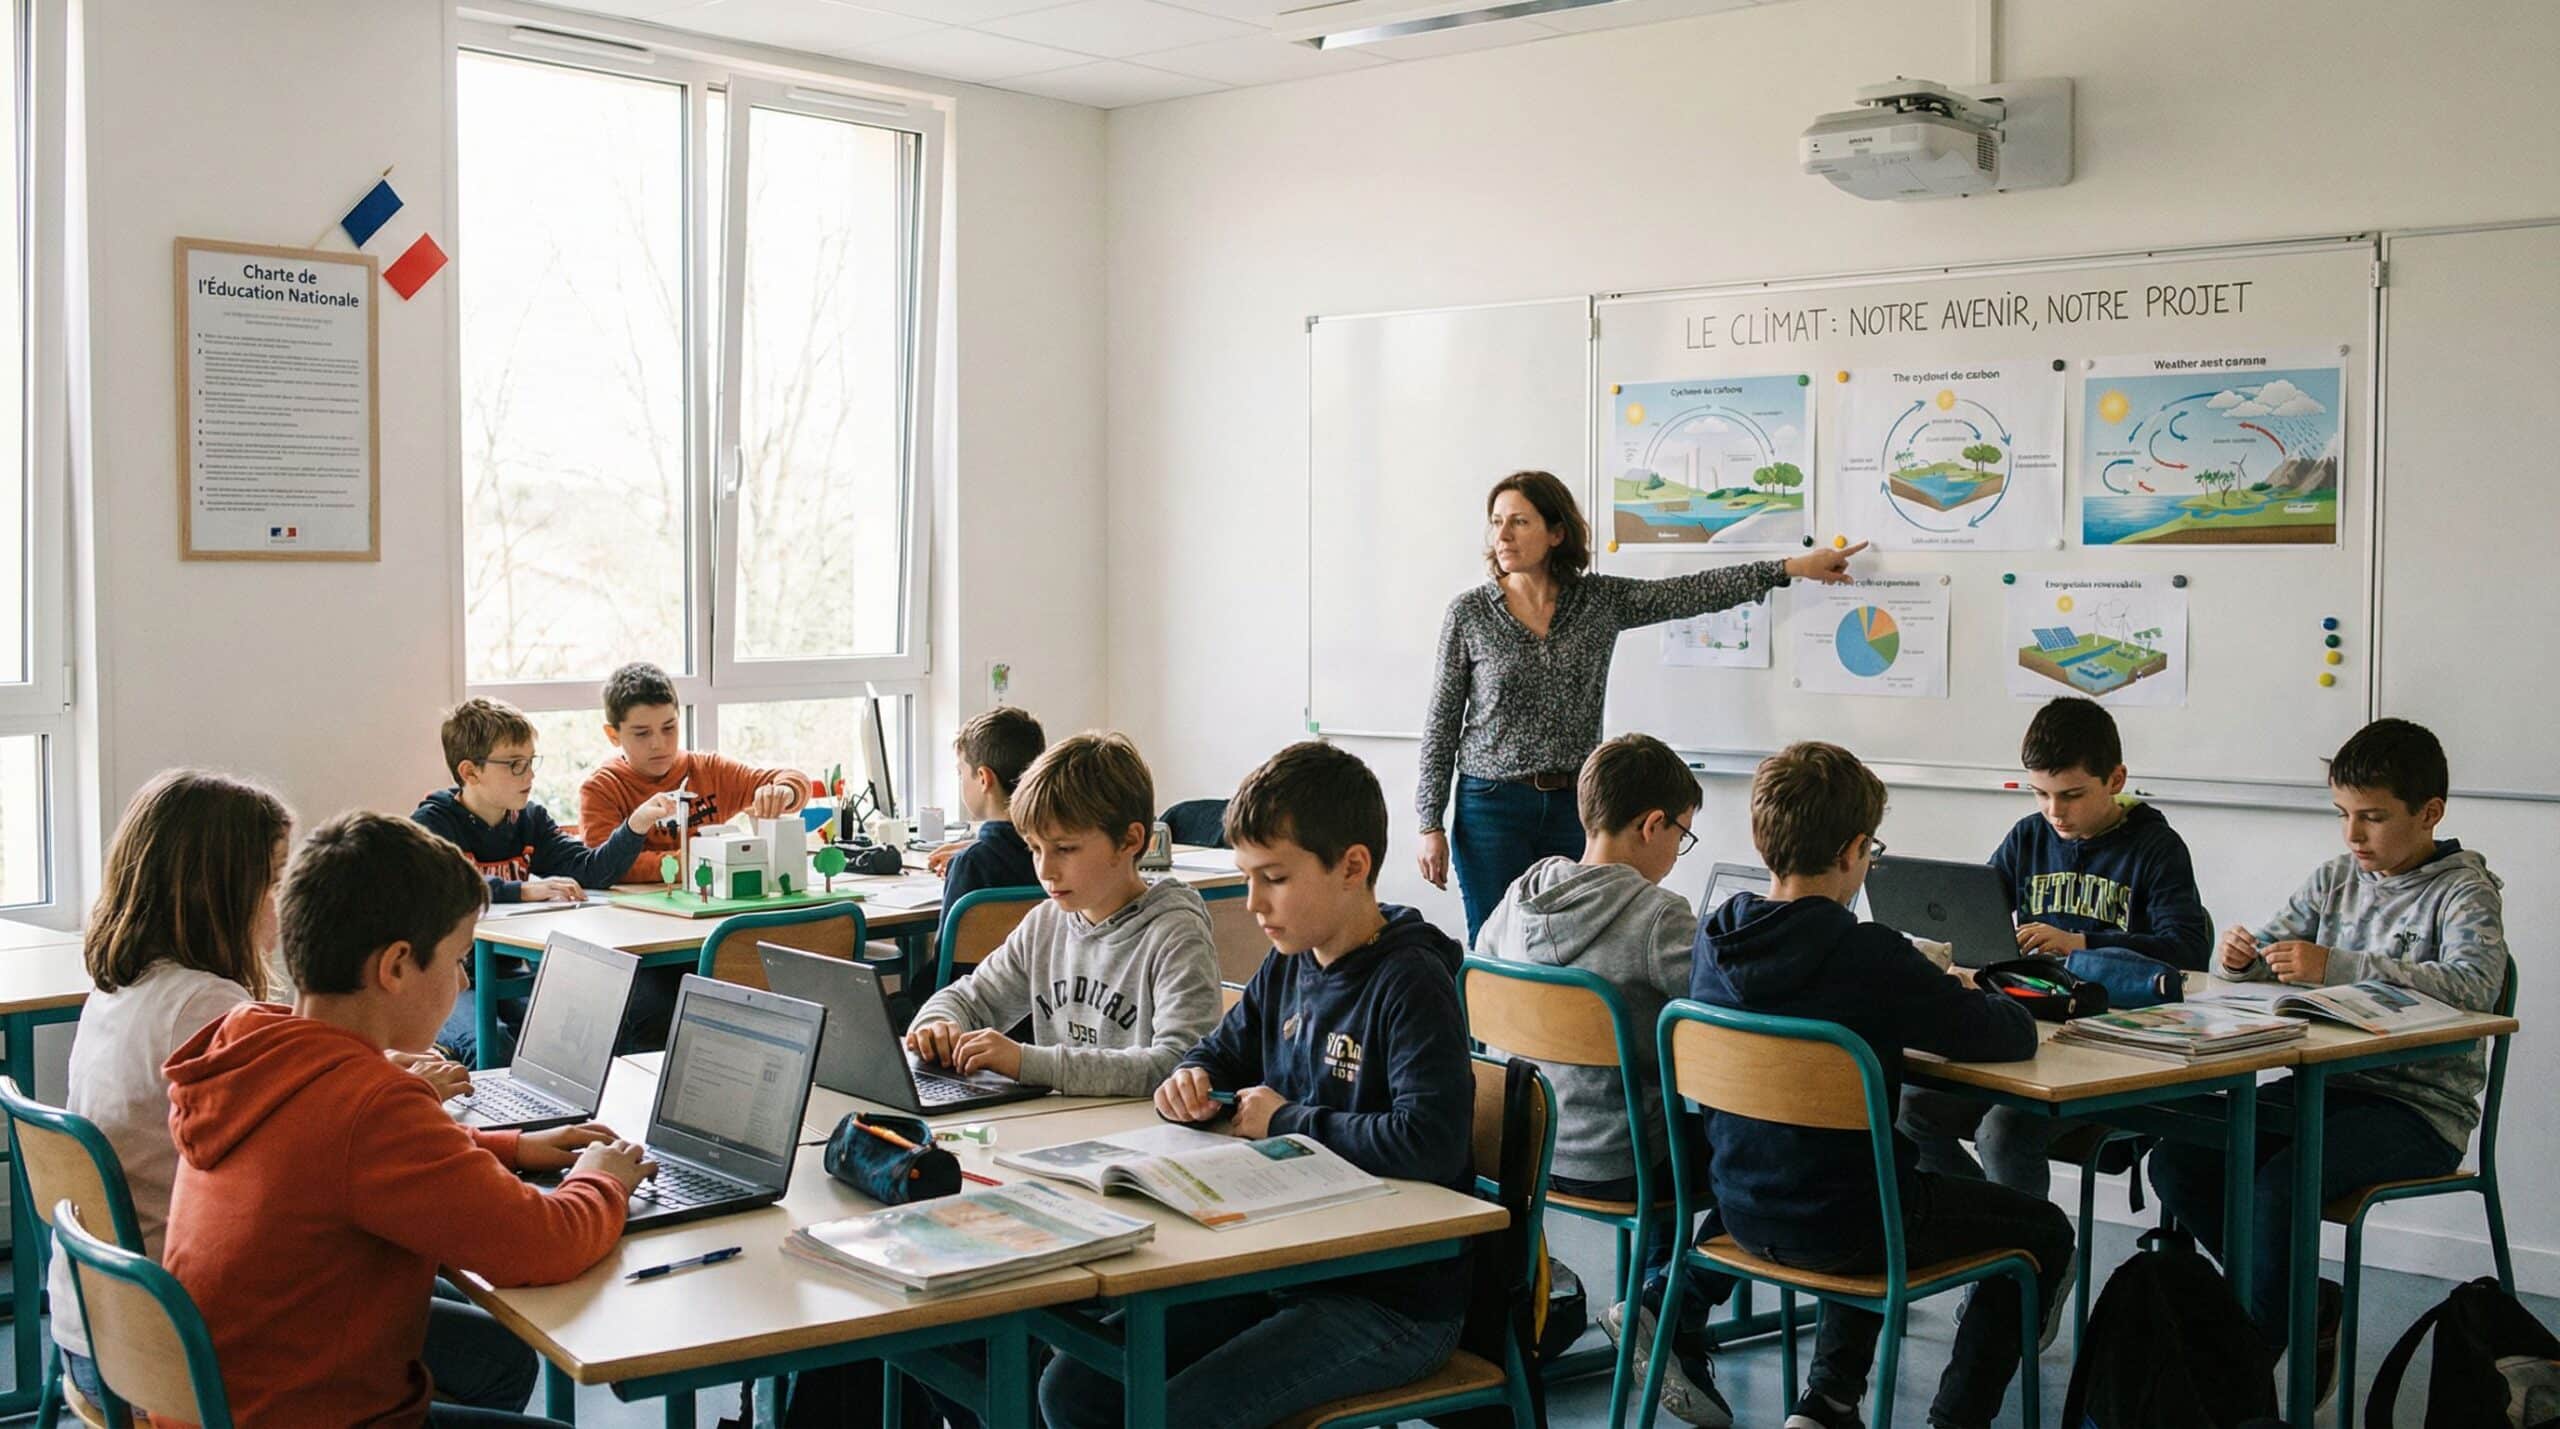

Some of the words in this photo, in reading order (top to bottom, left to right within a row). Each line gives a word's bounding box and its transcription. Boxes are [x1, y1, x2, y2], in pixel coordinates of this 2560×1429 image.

[243, 264, 295, 283] Charte
[298, 269, 317, 284] de
[198, 276, 285, 301] l'Éducation
[288, 287, 360, 308] Nationale
[1686, 315, 1717, 350] LE
[1849, 301, 1929, 337] NOTRE
[2047, 289, 2129, 325] NOTRE
[2146, 281, 2253, 318] PROJET
[1892, 372, 1911, 383] The
